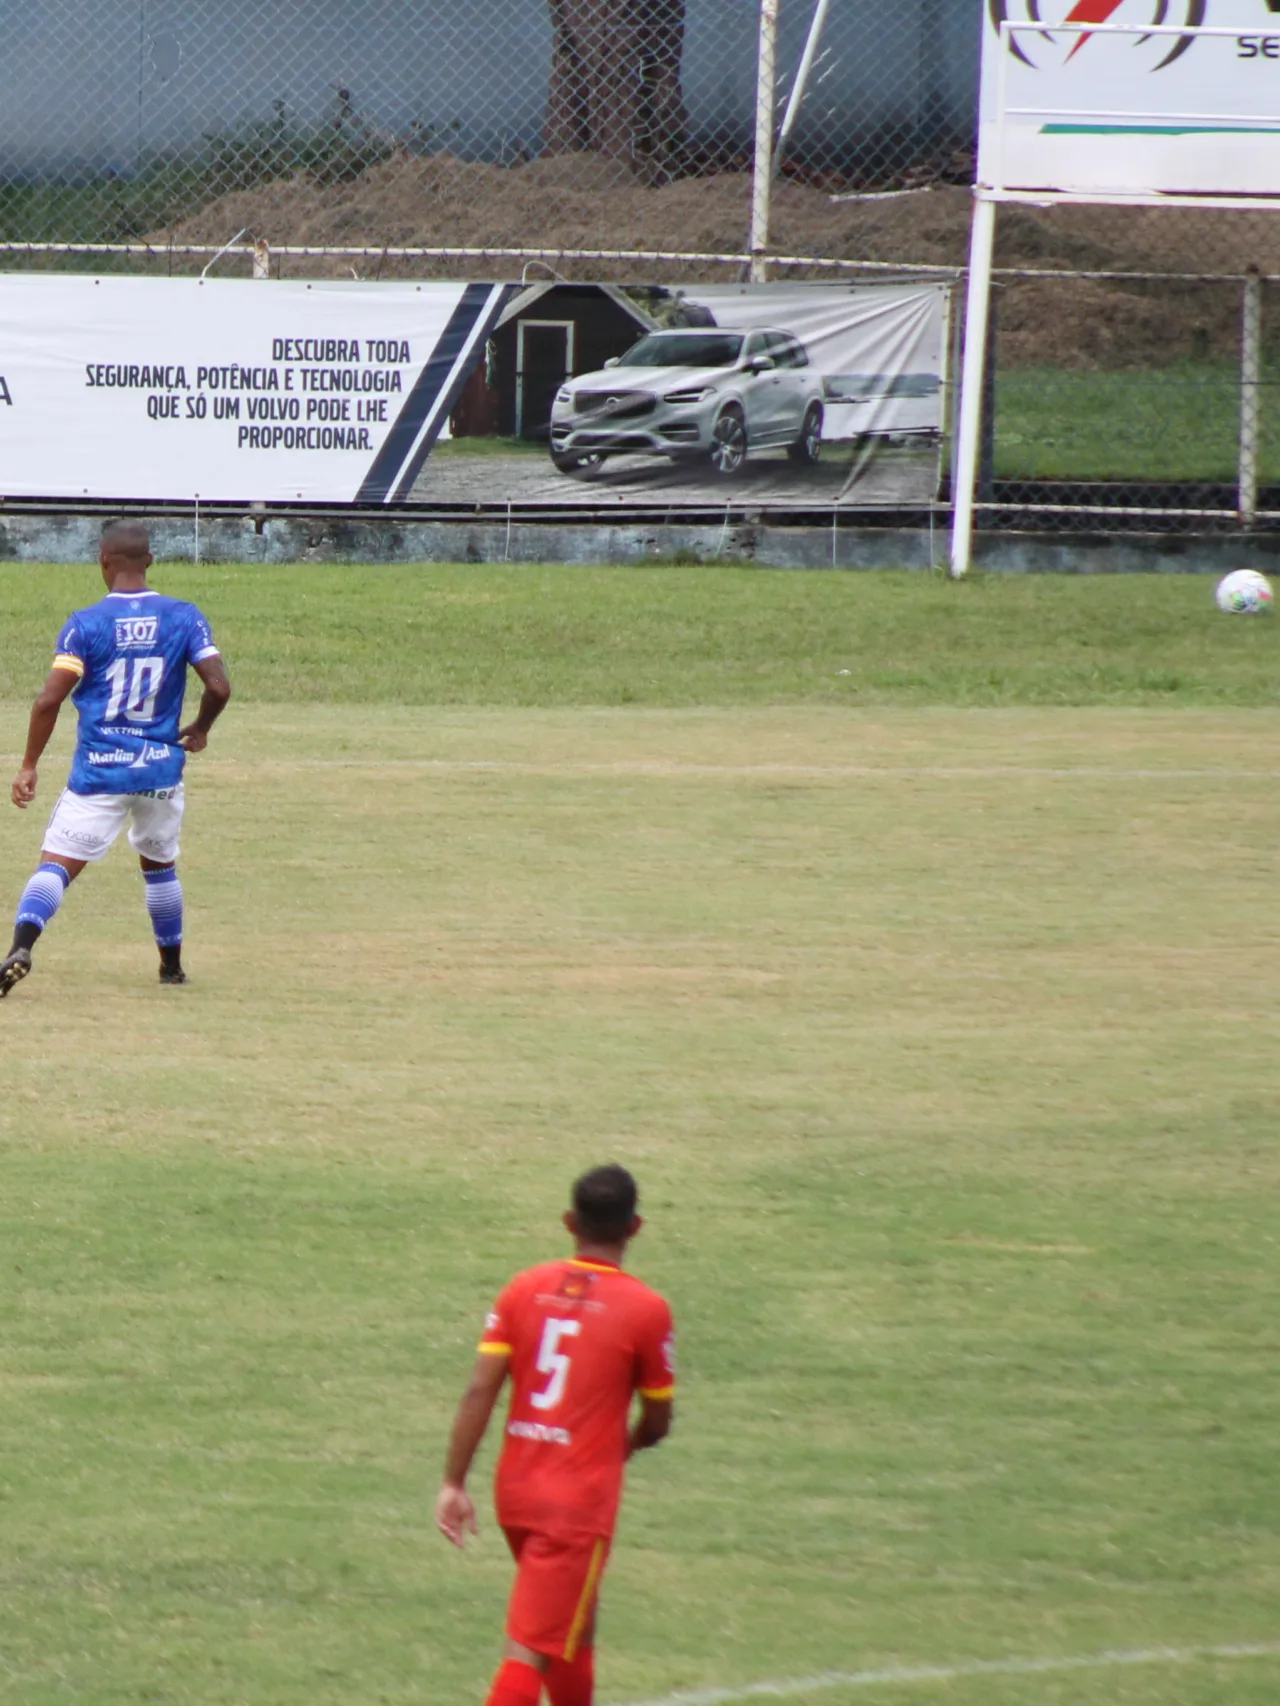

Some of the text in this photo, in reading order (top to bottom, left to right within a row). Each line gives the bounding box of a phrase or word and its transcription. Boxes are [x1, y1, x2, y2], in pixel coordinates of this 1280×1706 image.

[272, 338, 411, 363] DESCUBRA TODA
[85, 363, 402, 393] SEGURANÇA, POTÊNCIA E TECNOLOGIA
[147, 392, 388, 422] QUE SÓ UM VOLVO PODE LHE
[238, 425, 373, 450] PROPORCIONAR.
[123, 621, 157, 640] 107
[105, 656, 164, 722] 10
[146, 743, 170, 760] Azul
[530, 1317, 582, 1411] 5
